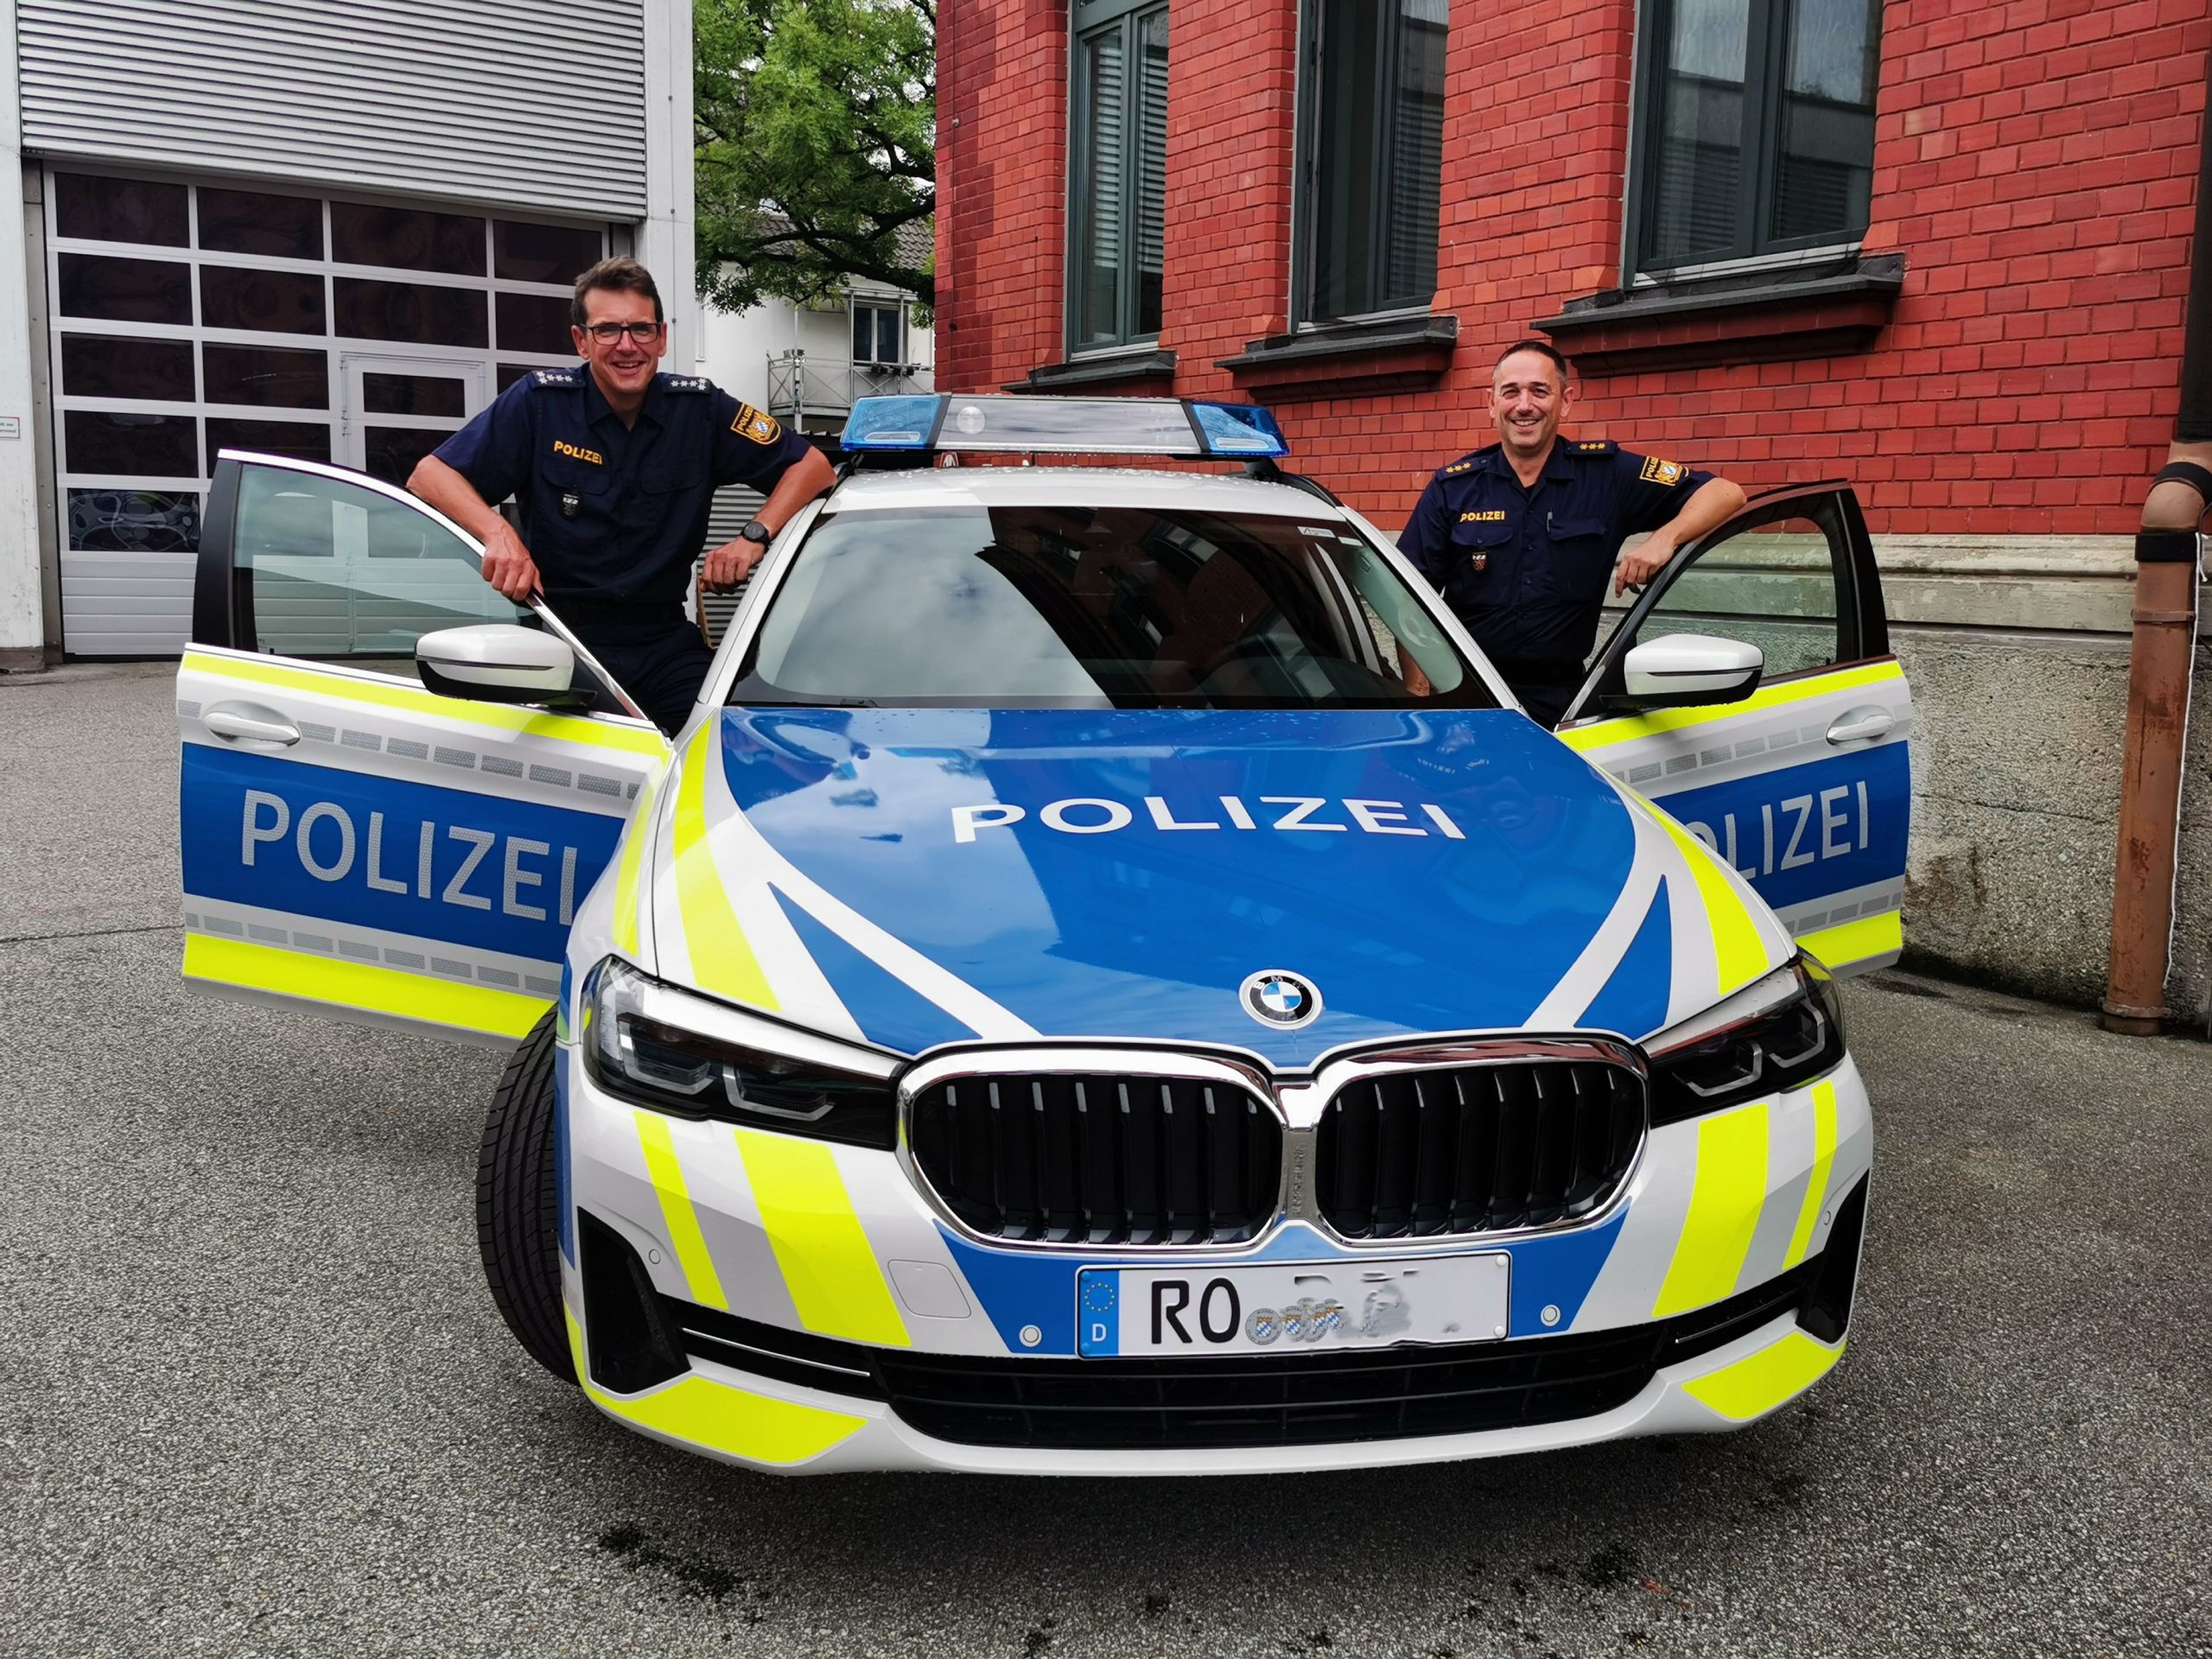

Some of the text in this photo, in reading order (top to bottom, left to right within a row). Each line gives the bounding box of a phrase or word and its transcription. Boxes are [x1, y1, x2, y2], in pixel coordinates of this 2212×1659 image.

[553, 440, 603, 465] POLIZEI
[1459, 510, 1506, 523] POLIZEI
[951, 796, 1466, 843] POLIZEI
[242, 789, 578, 926] POLIZEI
[1091, 1323, 1107, 1342] D
[1151, 1277, 1241, 1344] RO
